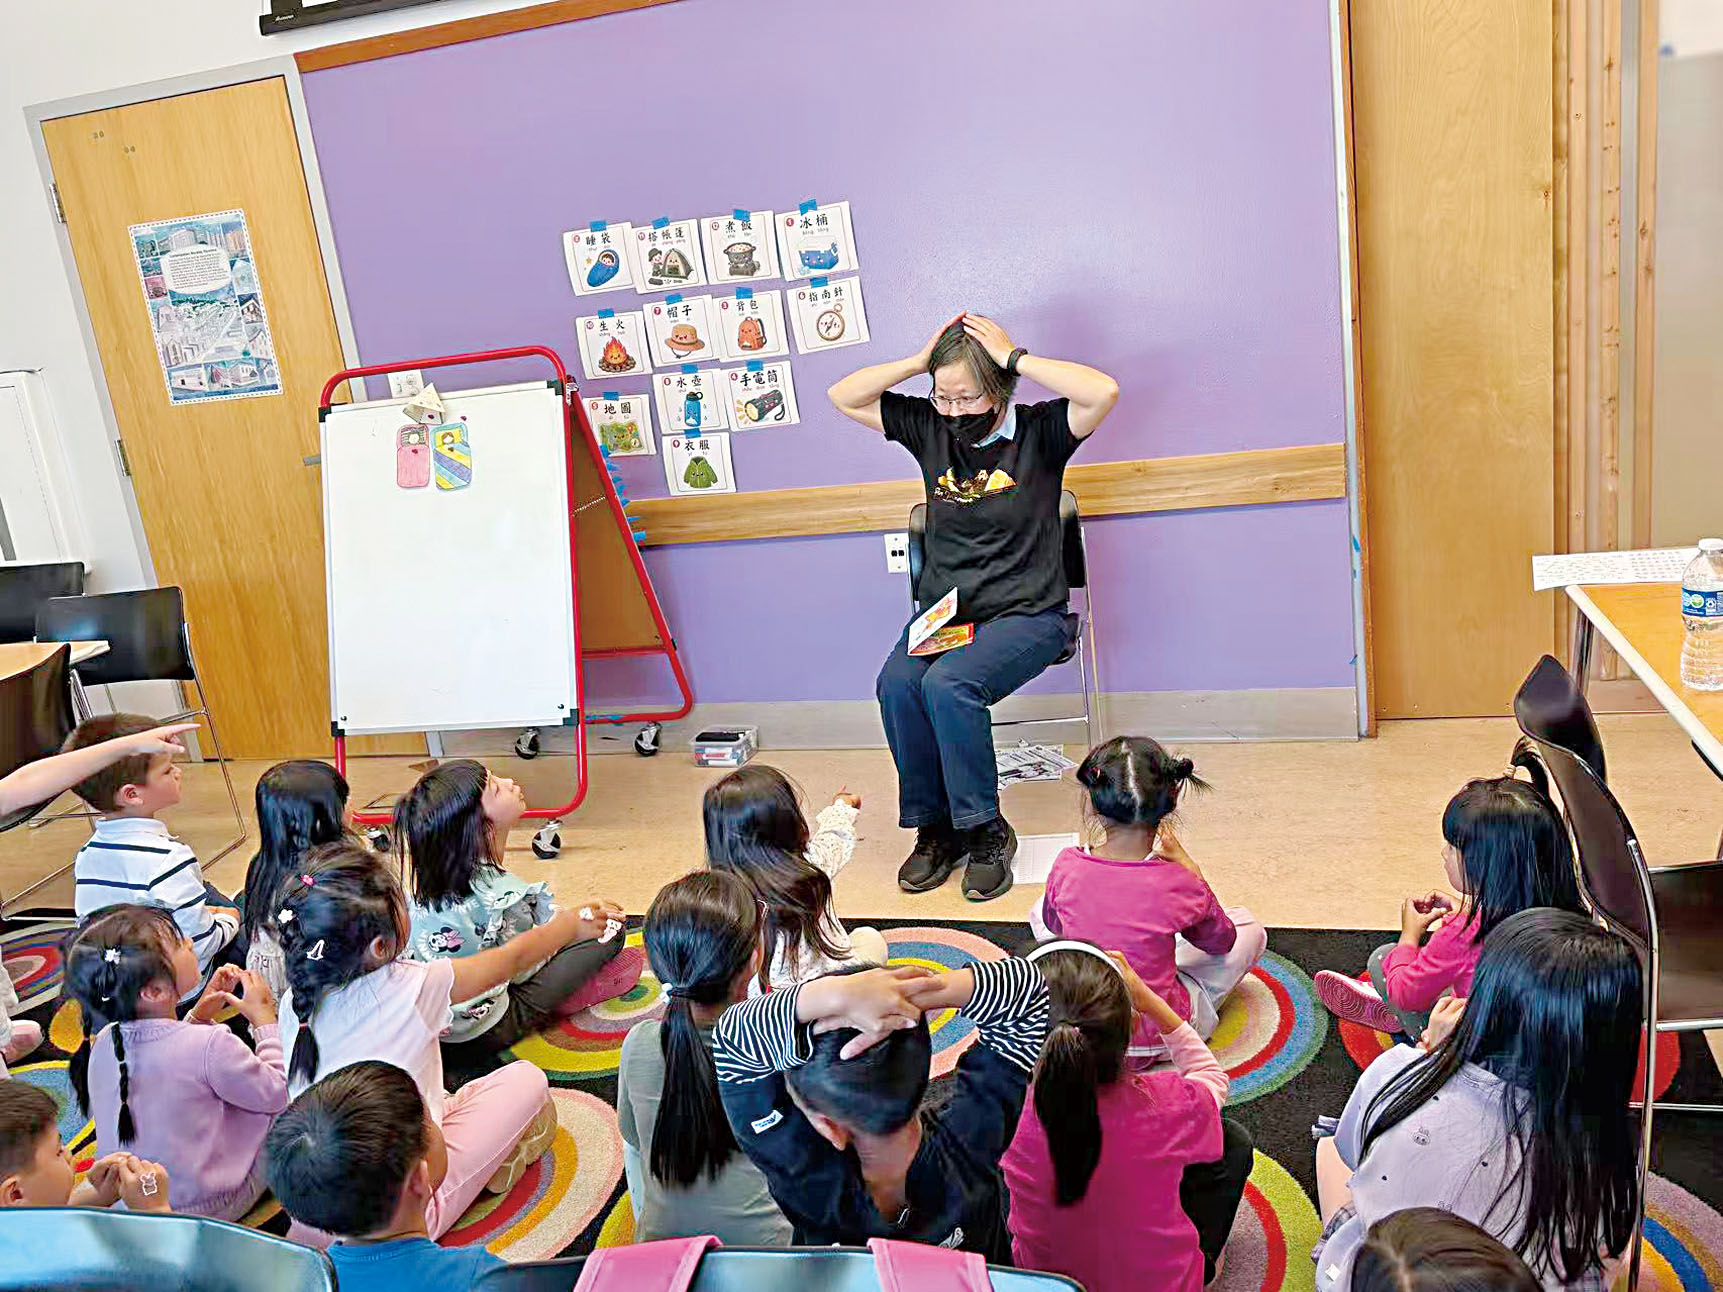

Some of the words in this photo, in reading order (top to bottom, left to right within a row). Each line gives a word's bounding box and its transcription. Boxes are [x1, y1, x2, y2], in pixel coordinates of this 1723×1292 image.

[799, 213, 828, 229] 冰桶
[809, 286, 843, 302] 指南針
[667, 304, 692, 318] 帽子
[736, 300, 759, 311] 背包
[599, 319, 625, 332] 生火
[740, 369, 778, 386] 手電筒
[603, 401, 631, 415] 地圖
[684, 439, 710, 451] 衣服
